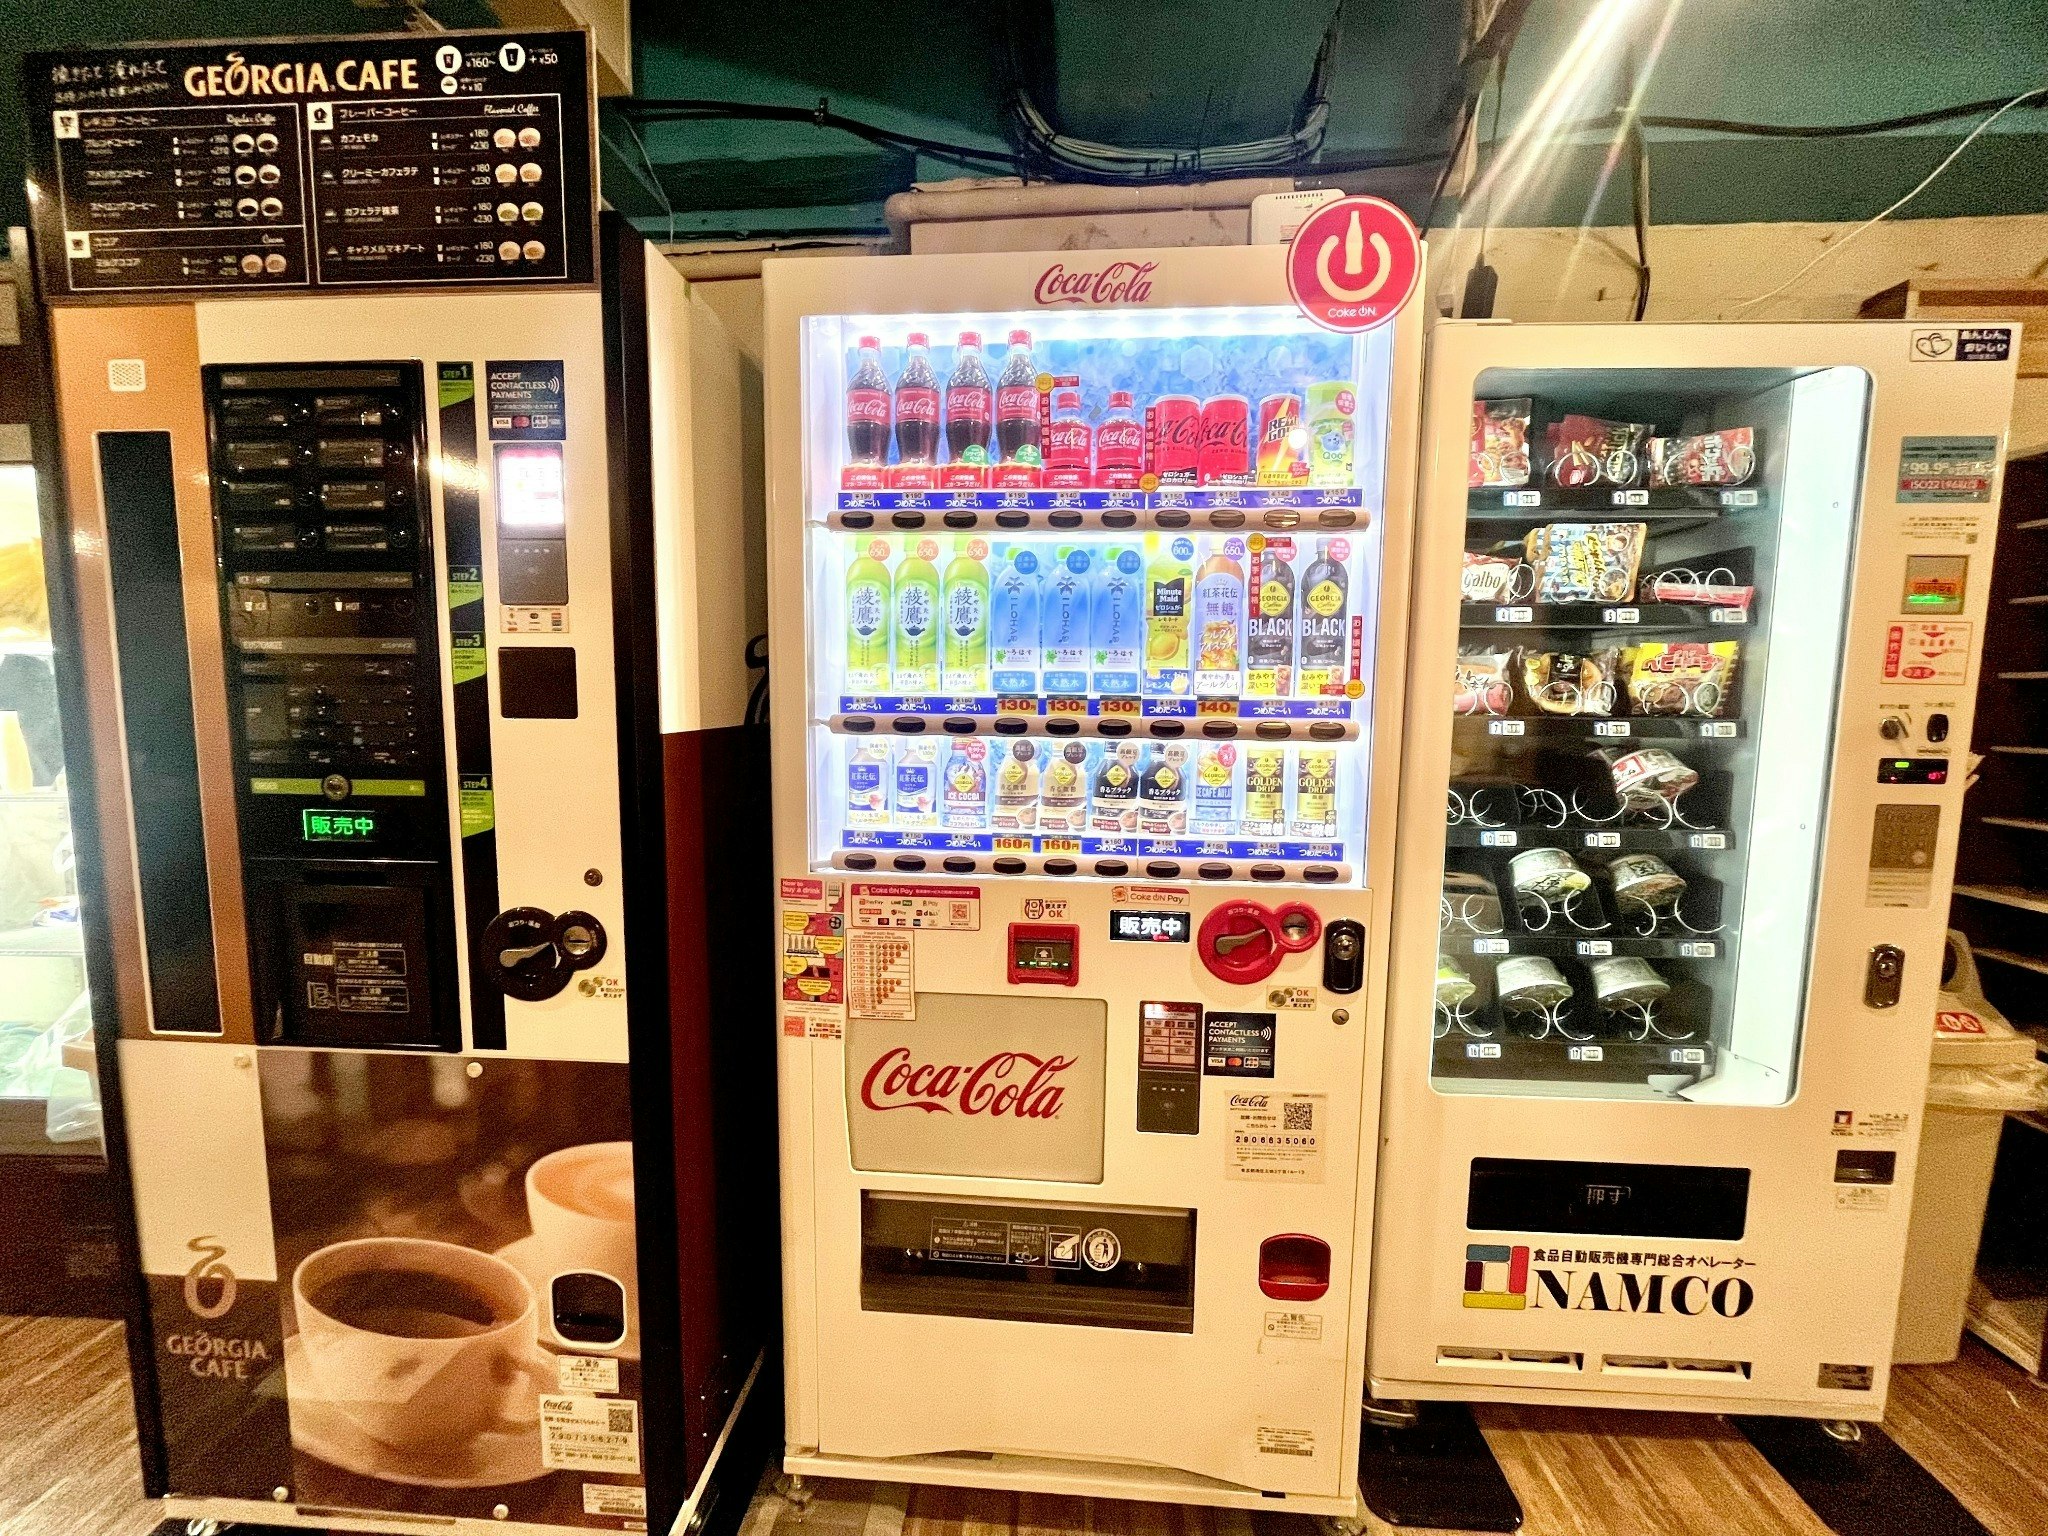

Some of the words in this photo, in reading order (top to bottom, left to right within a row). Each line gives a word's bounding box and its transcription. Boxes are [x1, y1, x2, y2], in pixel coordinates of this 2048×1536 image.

[184, 52, 330, 97] GEORGIA
[335, 58, 419, 92] CAFE
[339, 107, 418, 119] フレーバーコーヒー
[340, 133, 379, 144] カフェモカ
[342, 166, 419, 178] クリーミーカフェラテ
[346, 243, 425, 255] キャラメルマキアート
[1033, 260, 1161, 305] Coca-Cola
[1327, 306, 1357, 319] Coke
[490, 371, 522, 381] ACCEPT
[490, 380, 547, 391] CONTACTLESS
[490, 390, 532, 400] PAYMENTS
[1464, 567, 1501, 590] galbo
[1156, 588, 1182, 597] Minute
[1202, 588, 1238, 600] 紅茶花伝
[1158, 595, 1179, 603] Maid
[855, 586, 875, 626] 綾鷹
[903, 586, 924, 626] 綾鷹
[954, 586, 973, 626] 綾鷹
[1206, 602, 1236, 617] 無糖
[1248, 618, 1293, 637] BLACK
[1302, 618, 1346, 637] BLACK
[1000, 678, 1029, 689] 天然水
[1050, 678, 1080, 689] 天然水
[1101, 678, 1130, 689] 天然水
[999, 700, 1037, 712] 130円
[1047, 700, 1087, 713] 130円
[1101, 701, 1139, 713] 130円
[1198, 702, 1237, 714] 140円
[1247, 777, 1283, 786] GOLDEN
[1298, 778, 1335, 787] GOLDEN
[1308, 786, 1328, 794] DRIP
[310, 814, 374, 836] 販売中
[994, 838, 1032, 850] 160円
[1042, 840, 1080, 851] 160円
[1130, 892, 1151, 902] Coke
[1167, 894, 1184, 904] Pay
[1048, 909, 1064, 918] OK
[1119, 916, 1181, 936] 販売中
[605, 978, 619, 986] OK
[1296, 988, 1310, 997] OK
[1208, 1028, 1260, 1037] CONTACTLESS
[1208, 1036, 1246, 1044] PAYMENTS
[860, 1046, 1080, 1120] Coca-Cola
[1229, 1093, 1271, 1109] Coca-Cola
[1533, 1248, 1757, 1270] 食品自動販売機専門総合オペレーター
[1530, 1268, 1754, 1318] NAMCO
[165, 1328, 266, 1360] GEORGIA
[189, 1358, 248, 1380] CAFE
